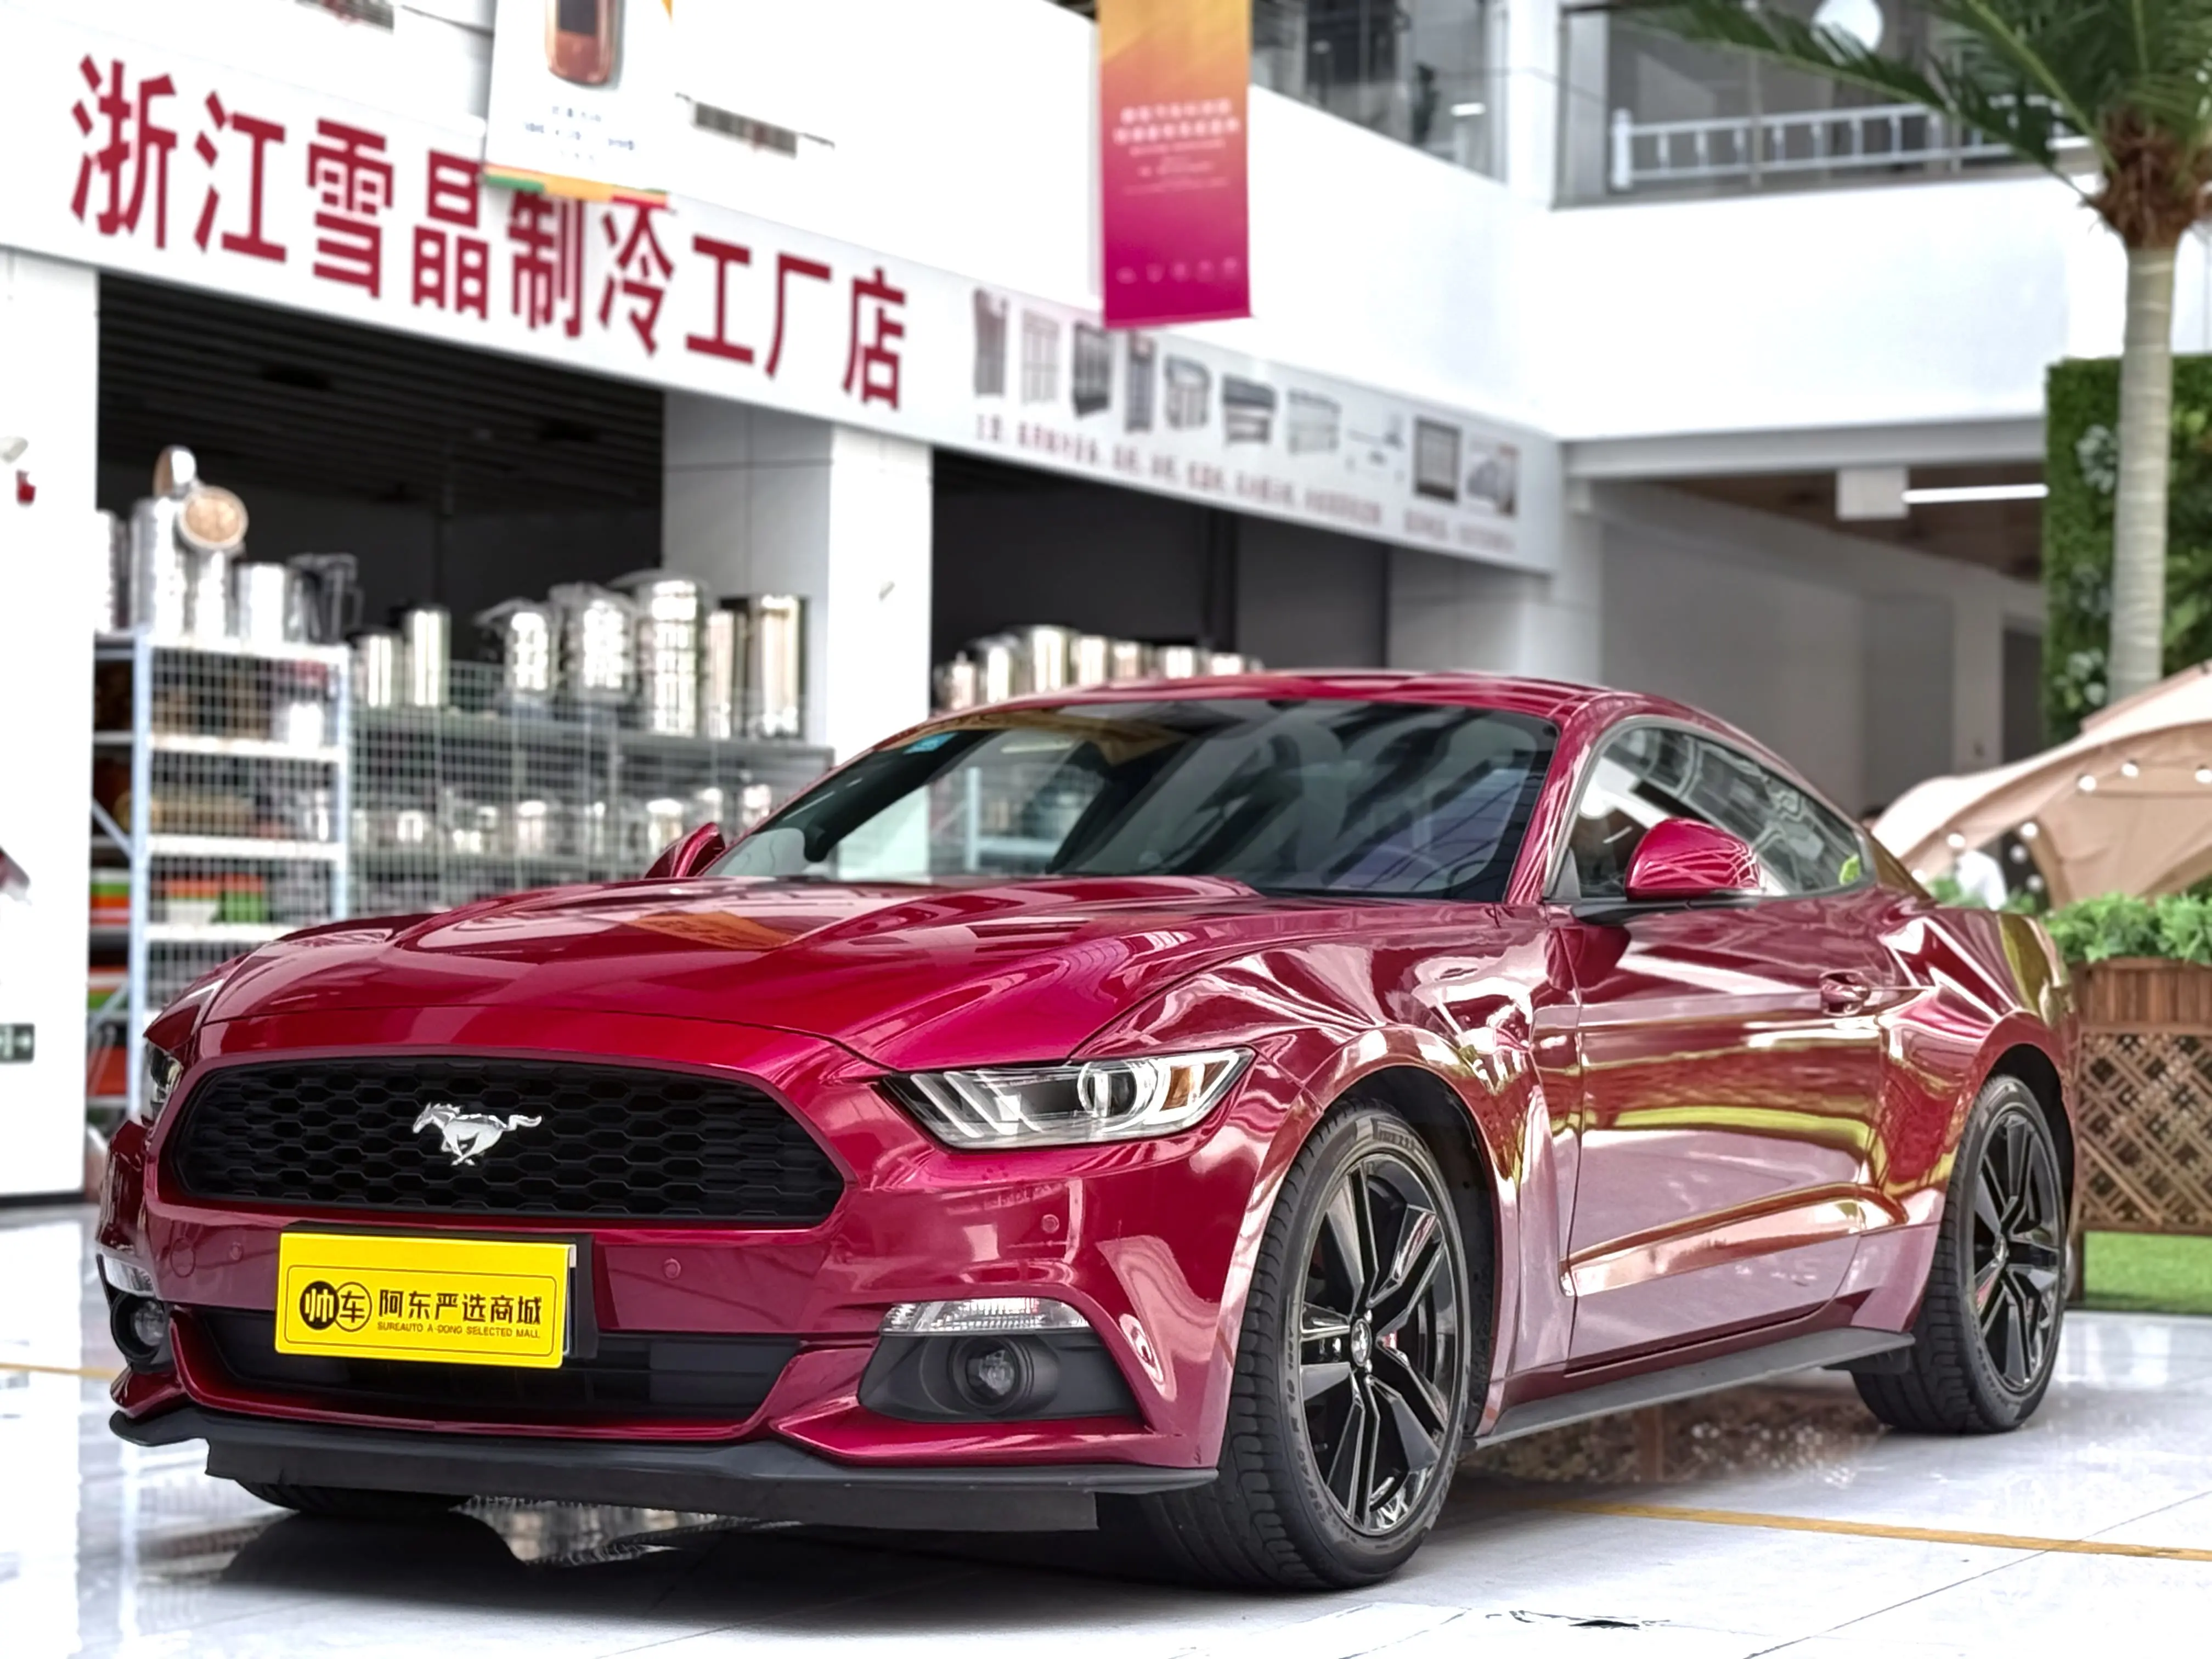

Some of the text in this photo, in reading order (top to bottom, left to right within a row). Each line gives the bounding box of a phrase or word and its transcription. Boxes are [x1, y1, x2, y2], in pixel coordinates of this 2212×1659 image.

[70, 54, 907, 411] 浙江雪晶制冷工厂店
[303, 1285, 368, 1327] 帅车
[379, 1289, 543, 1325] 阿东严选商城
[377, 1321, 424, 1333] SUREAUTO
[466, 1326, 513, 1338] SELECTED
[516, 1329, 541, 1339] MALL
